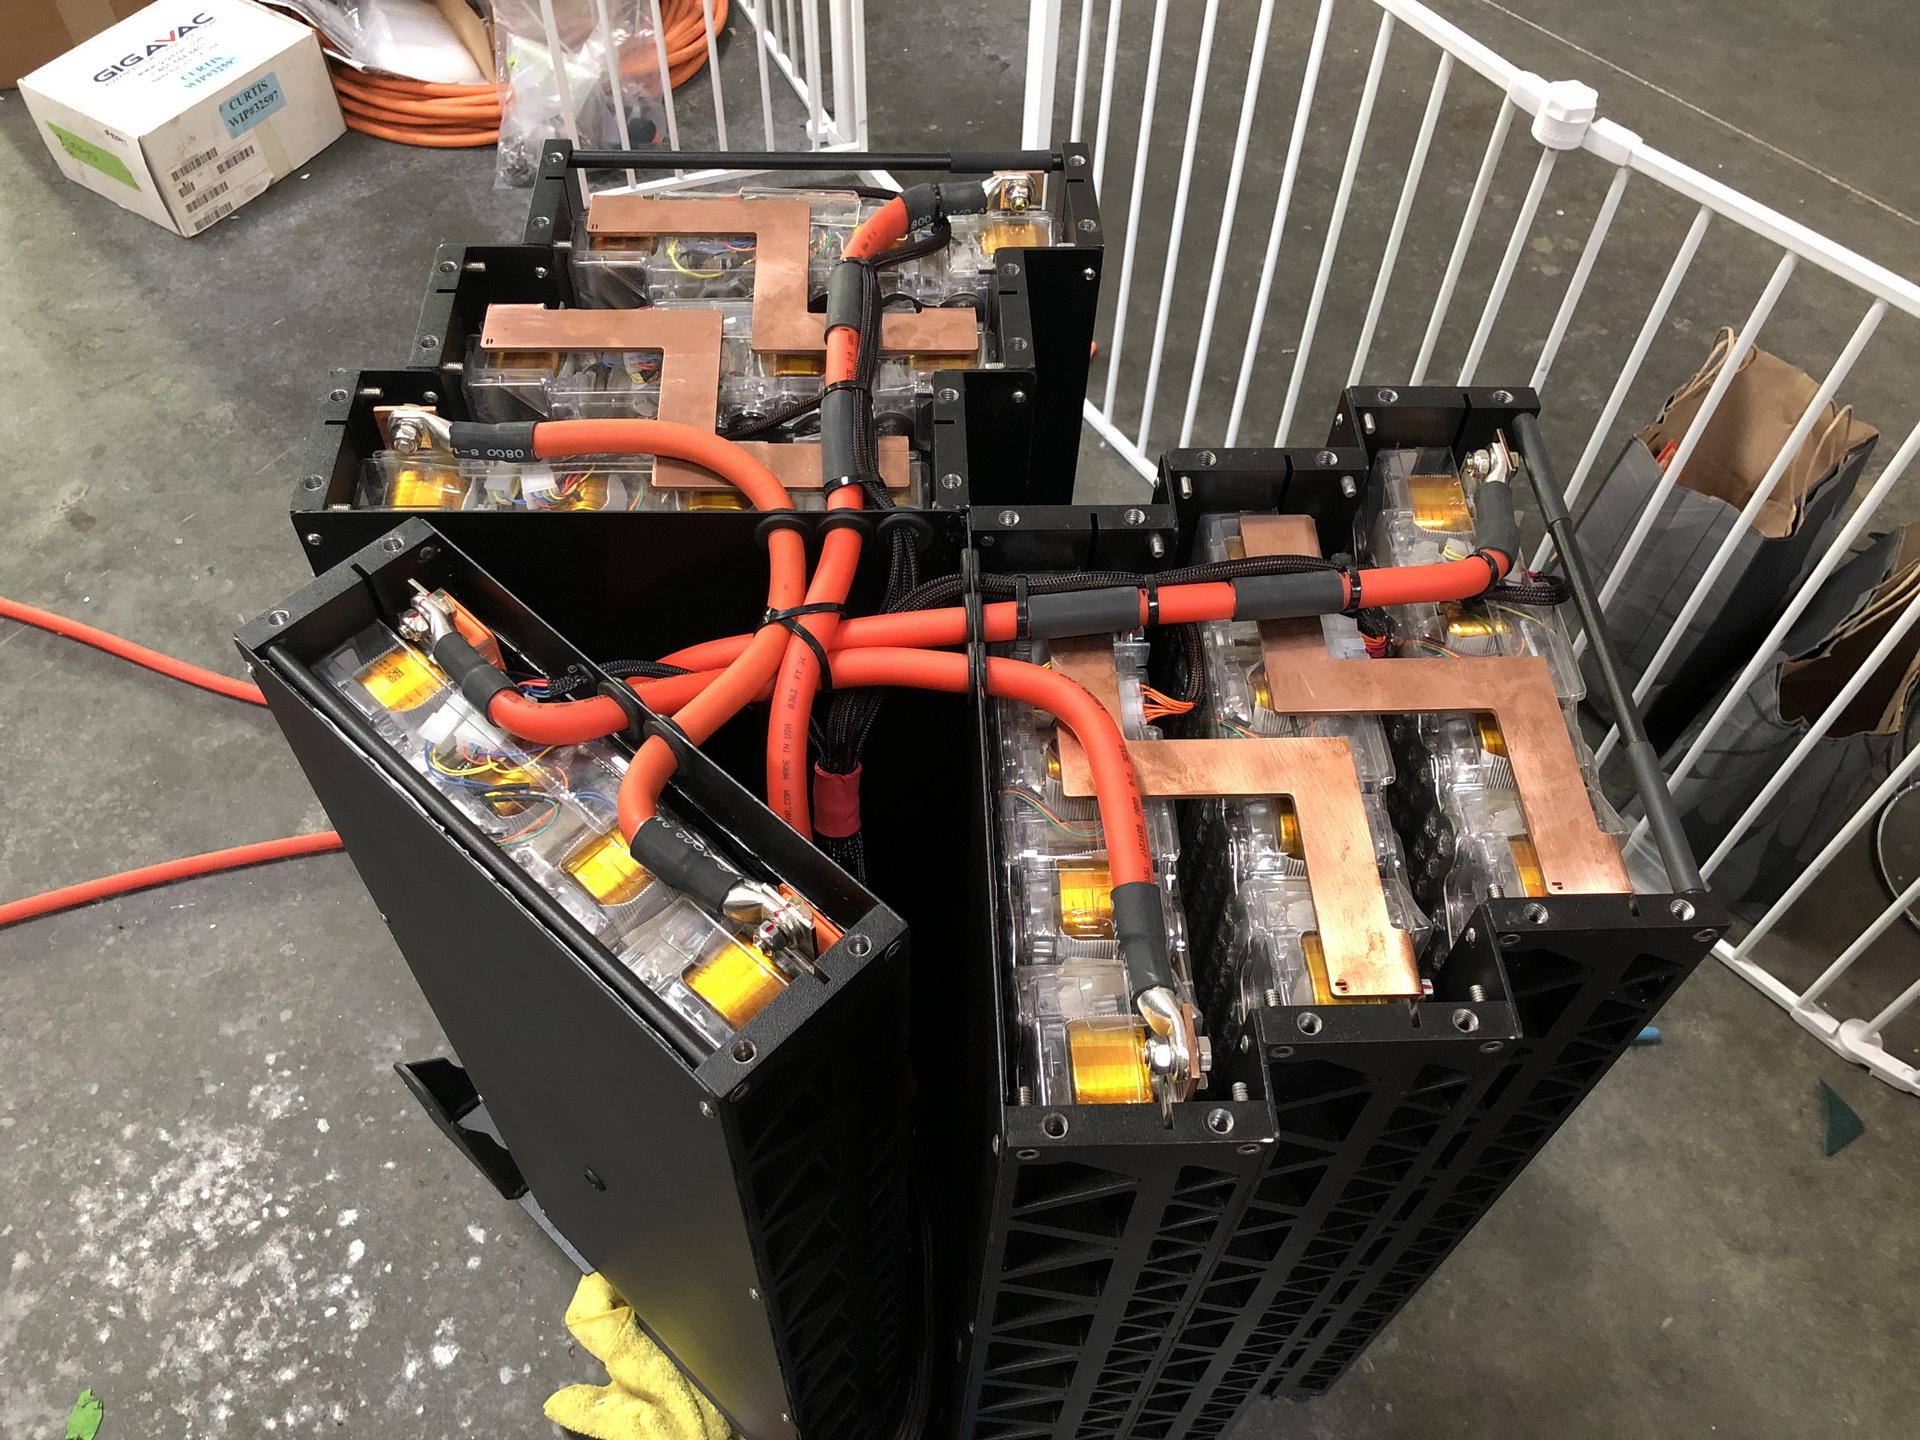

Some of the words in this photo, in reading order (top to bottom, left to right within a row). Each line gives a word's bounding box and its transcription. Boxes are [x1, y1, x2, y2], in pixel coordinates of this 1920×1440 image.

[93, 12, 214, 82] GIGAVAC
[181, 56, 222, 81] CURTIS
[229, 80, 268, 111] CURTIS
[228, 90, 279, 127] WIP#32597
[784, 723, 792, 739] USA
[782, 743, 791, 753] IN
[782, 759, 791, 780] MADE
